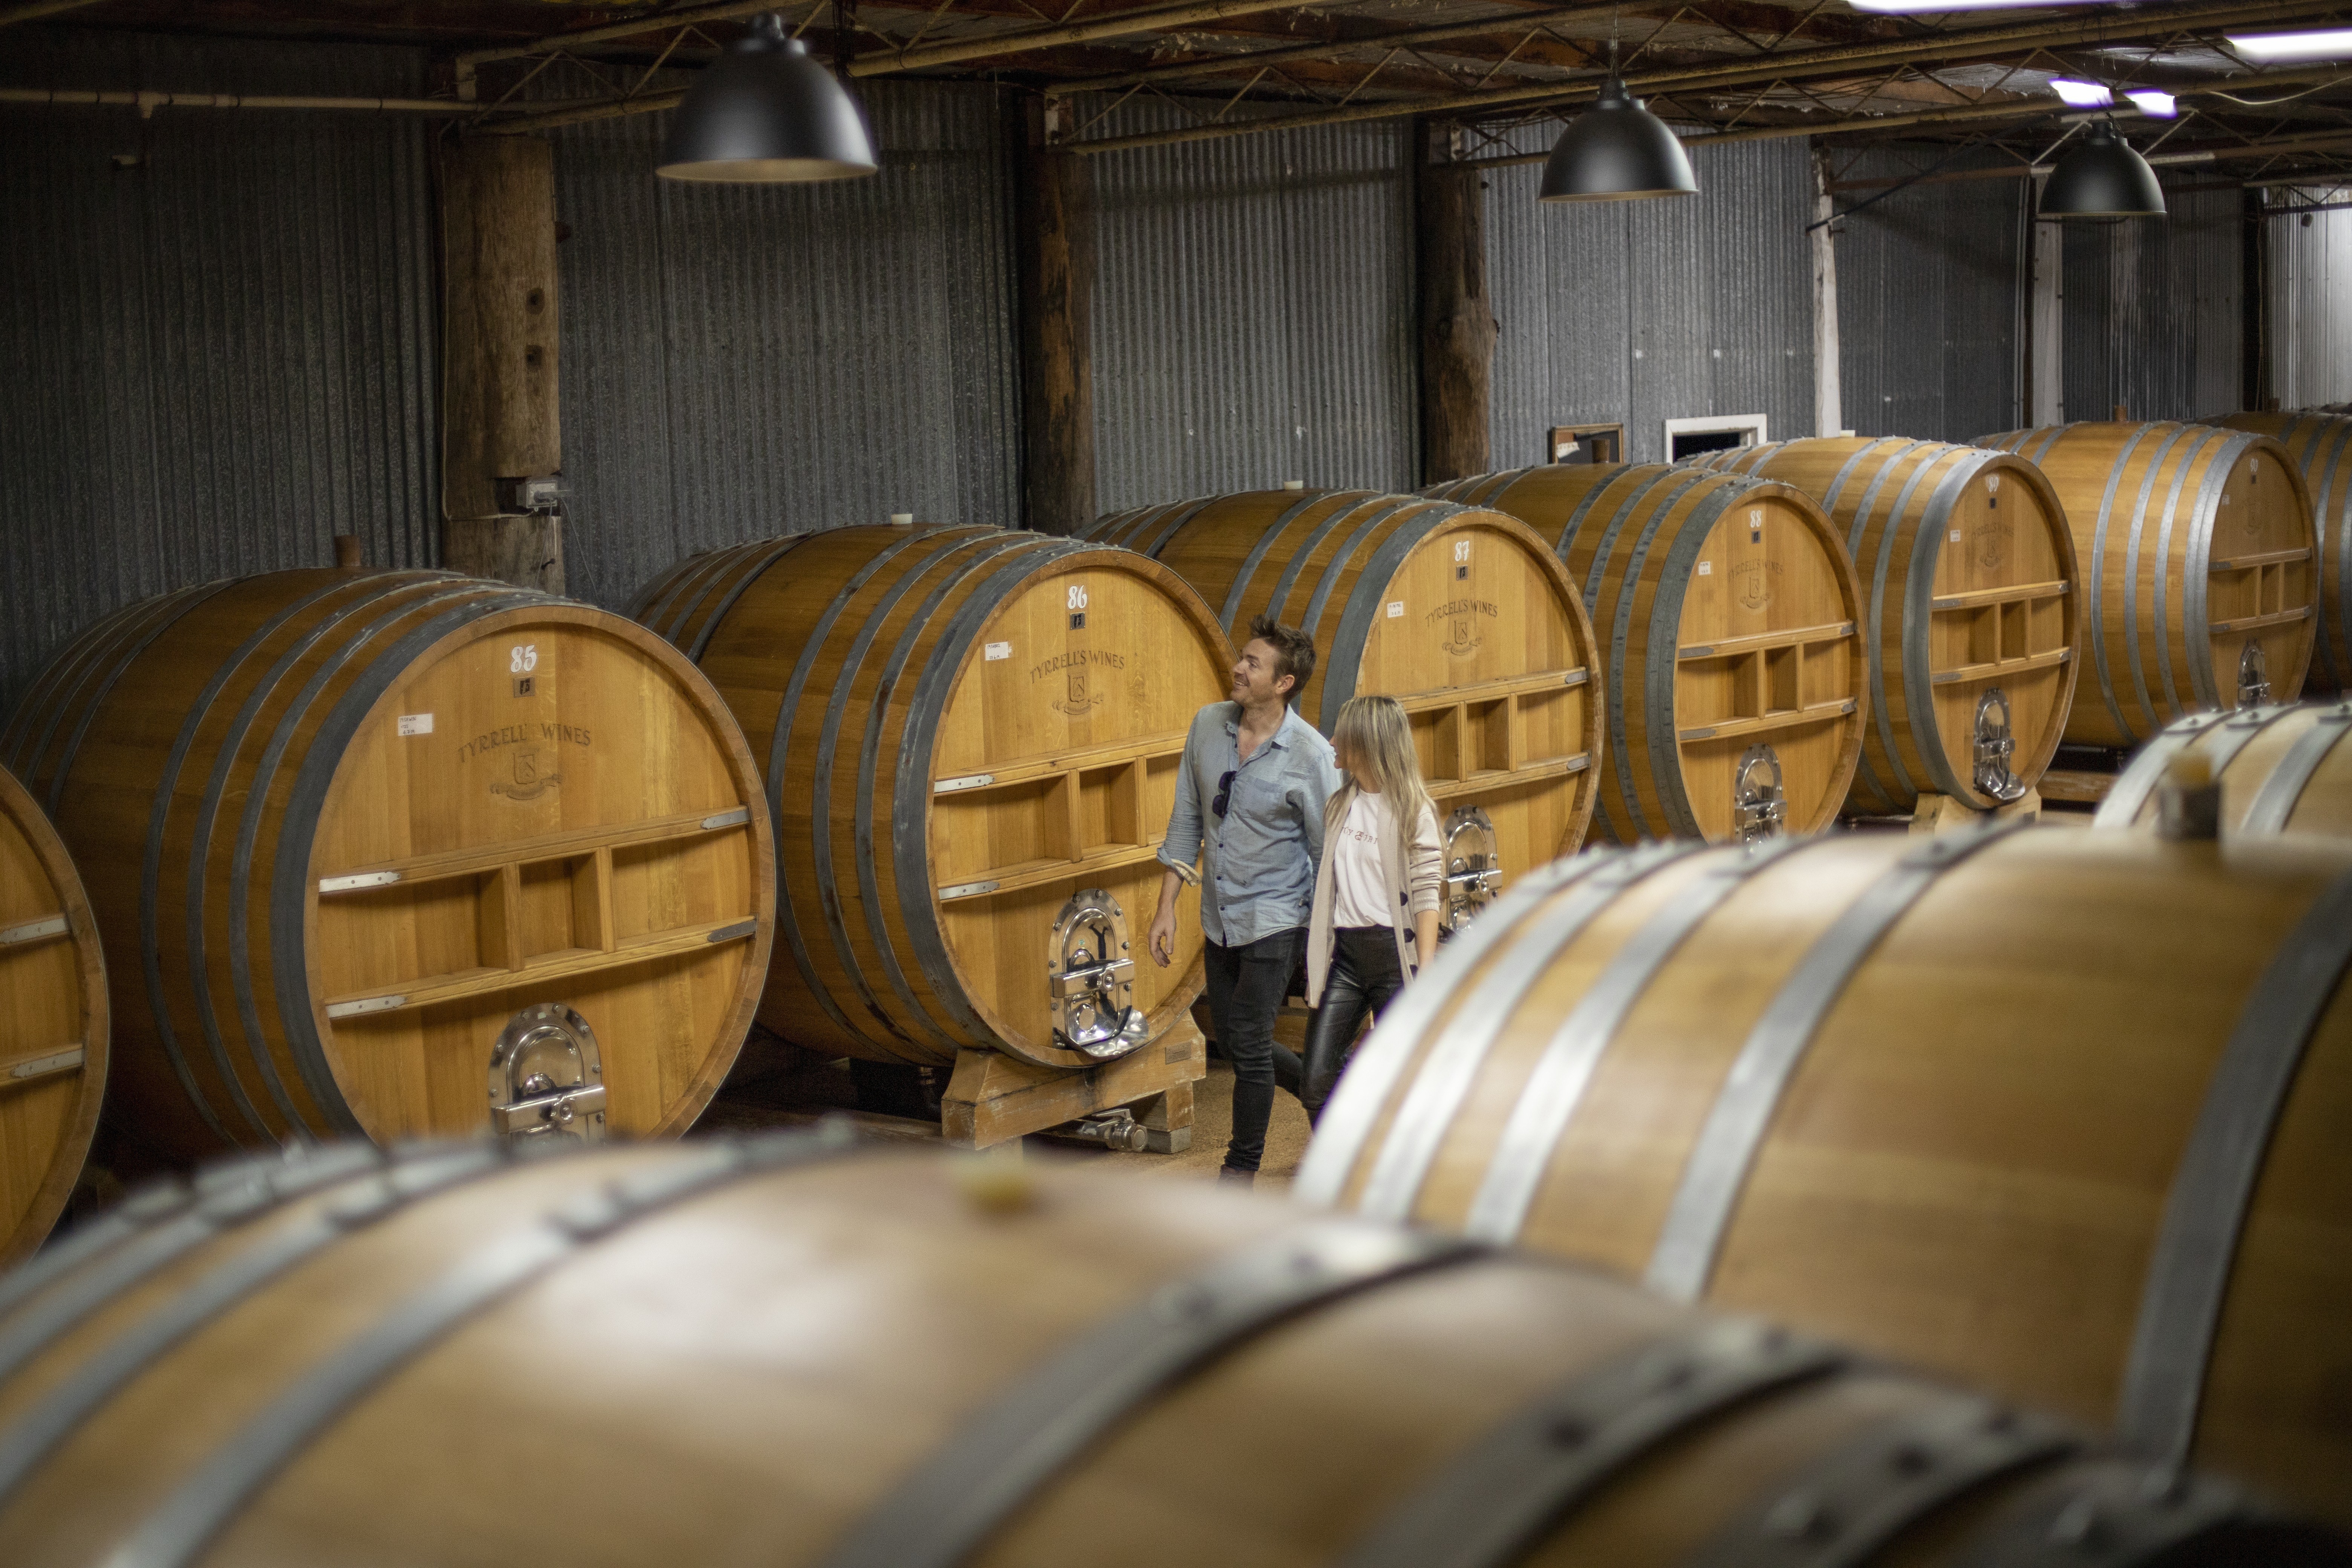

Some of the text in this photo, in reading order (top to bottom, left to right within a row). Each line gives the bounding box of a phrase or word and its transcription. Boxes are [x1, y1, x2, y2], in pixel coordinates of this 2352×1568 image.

[1750, 510, 1761, 528] 88
[1455, 540, 1470, 562] 87
[1067, 585, 1087, 609] 86
[1470, 599, 1498, 617] WINES
[510, 645, 537, 673] 85
[1030, 650, 1124, 684] TYRRELL'S WINES
[541, 723, 591, 746] WINES
